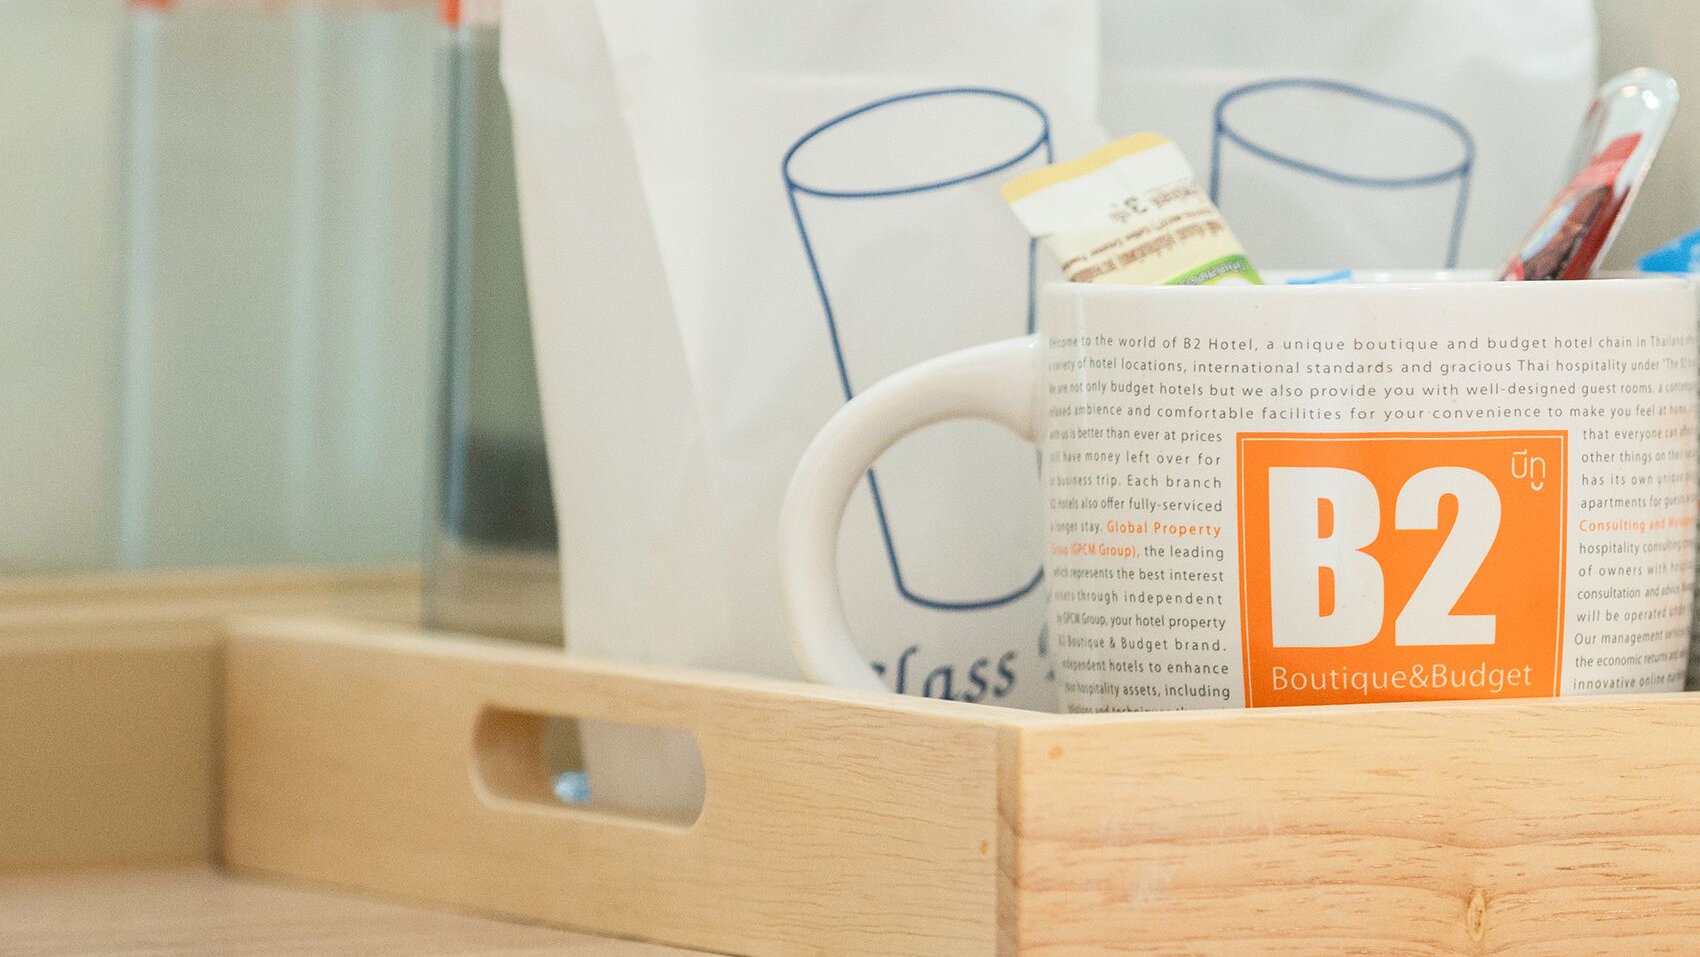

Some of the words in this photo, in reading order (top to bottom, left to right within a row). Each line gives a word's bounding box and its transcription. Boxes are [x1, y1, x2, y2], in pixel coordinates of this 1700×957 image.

[1095, 332, 1114, 347] the
[1118, 334, 1156, 350] world
[1162, 335, 1177, 350] of
[1183, 336, 1202, 351] B2
[1207, 337, 1260, 354] Hotel,
[1266, 339, 1275, 351] a
[1282, 337, 1346, 354] unique
[1352, 337, 1439, 354] boutique
[1446, 336, 1480, 351] and
[1486, 336, 1548, 353] budget
[1553, 336, 1593, 349] hotel
[1598, 336, 1633, 349] chain
[1636, 336, 1647, 347] in
[1089, 355, 1117, 370] hotel
[1120, 356, 1188, 375] locations,
[1192, 360, 1300, 376] international
[1305, 360, 1394, 375] standards
[1400, 360, 1433, 375] and
[1439, 359, 1512, 375] gracious
[1517, 358, 1550, 371] Thai
[1555, 358, 1627, 375] hospitality
[1631, 358, 1660, 371] under
[1085, 379, 1107, 395] only
[1110, 380, 1155, 397] budget
[1158, 381, 1204, 397] hotels
[1209, 383, 1236, 398] but
[1241, 385, 1264, 398] we
[1269, 384, 1304, 398] also
[1309, 383, 1377, 401] provide
[1383, 386, 1415, 401] you
[1421, 384, 1460, 397] with
[1466, 383, 1577, 399] well-designed
[1581, 382, 1617, 398] guest
[1620, 383, 1656, 395] rooms,
[1073, 402, 1123, 416] ambience
[1126, 403, 1152, 418] and
[1156, 404, 1254, 420] comfortable
[1262, 405, 1343, 421] facilities
[1349, 405, 1376, 421] for
[1383, 408, 1425, 424] your
[1431, 405, 1541, 421] convenience
[1548, 406, 1563, 419] to
[1569, 404, 1605, 419] make
[1609, 406, 1632, 420] you
[1635, 403, 1656, 418] feel
[1077, 426, 1104, 440] better
[1106, 425, 1131, 440] than
[1133, 430, 1160, 442] ever
[1163, 429, 1177, 442] at
[1180, 428, 1224, 445] prices
[1582, 427, 1609, 441] that
[1614, 429, 1663, 443] everyone
[1084, 451, 1121, 466] money
[1125, 450, 1150, 464] left
[1156, 453, 1190, 466] over
[1197, 452, 1222, 467] for
[1581, 450, 1616, 464] other
[1619, 449, 1653, 466] things
[1095, 473, 1122, 489] trip.
[1126, 474, 1158, 489] Each
[1165, 475, 1222, 490] branch
[1581, 473, 1604, 485] has
[1610, 473, 1626, 486] its
[1630, 474, 1654, 486] own
[1080, 498, 1099, 510] also
[1100, 497, 1125, 510] offer
[1128, 497, 1223, 514] fully-serviced
[1580, 497, 1647, 511] apartments
[1649, 493, 1662, 507] for
[1080, 521, 1104, 535] stay.
[1106, 519, 1149, 535] Global
[1153, 521, 1222, 539] Property
[1578, 519, 1646, 534] Consulting
[1144, 545, 1165, 558] the
[1169, 545, 1225, 562] leading
[1268, 465, 1502, 649] B2
[1578, 541, 1640, 556] hospitality
[1116, 568, 1135, 580] the
[1138, 568, 1166, 581] best
[1169, 569, 1225, 583] interest
[1578, 565, 1593, 578] of
[1598, 565, 1643, 577] owners
[1076, 589, 1119, 606] through
[1123, 591, 1224, 607] independent
[1576, 587, 1642, 601] consultation
[1110, 616, 1133, 628] your
[1135, 614, 1165, 628] hotel
[1168, 617, 1226, 632] property
[1576, 609, 1601, 623] will
[1605, 609, 1621, 622] be
[1623, 606, 1667, 623] operated
[1109, 636, 1116, 650] &
[1120, 636, 1168, 653] Budget
[1174, 638, 1228, 652] brand.
[1574, 632, 1598, 646] Our
[1600, 630, 1664, 647] management
[1108, 659, 1145, 674] hotels
[1149, 661, 1162, 674] to
[1166, 661, 1230, 675] enhance
[1574, 655, 1595, 669] the
[1596, 653, 1642, 667] economic
[871, 643, 1017, 703] lass
[1271, 662, 1533, 696] Boutique&Budget
[1572, 674, 1637, 691] innovative
[1122, 684, 1161, 697] assets,
[1164, 683, 1231, 701] including
